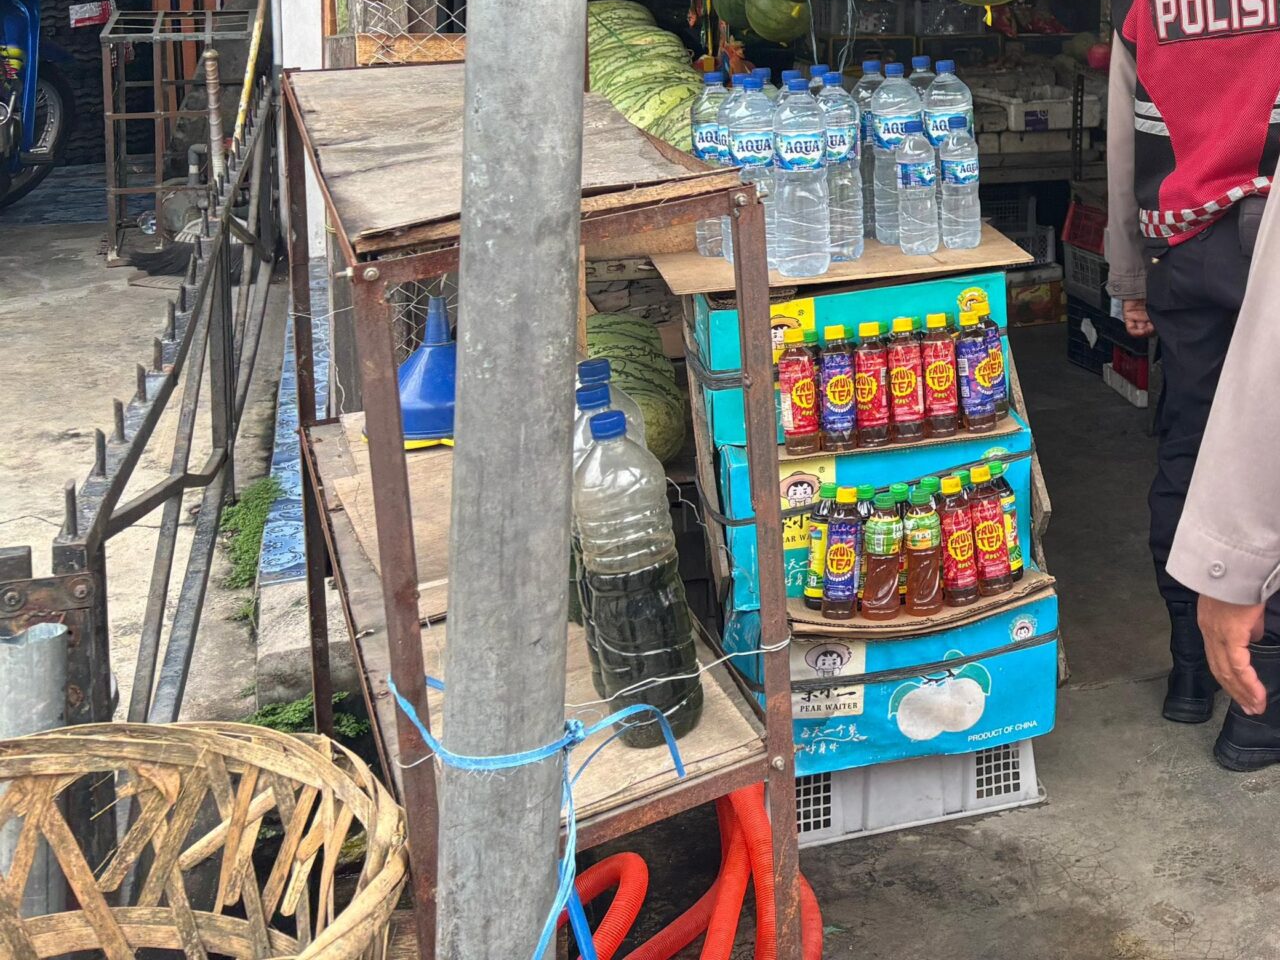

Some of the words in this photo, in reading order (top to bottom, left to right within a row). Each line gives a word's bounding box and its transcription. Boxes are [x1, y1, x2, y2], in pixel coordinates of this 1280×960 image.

[736, 138, 772, 155] AQUA
[784, 139, 821, 156] AQUA
[928, 362, 951, 376] FRUIT
[829, 376, 852, 389] FRUIT
[891, 380, 912, 395] TEA
[930, 376, 951, 390] TEA
[830, 387, 852, 401] TEA
[976, 522, 1001, 537] FRUIT
[950, 532, 972, 547] FRUIT
[978, 535, 1002, 549] TEA
[828, 546, 853, 558] FRUIT
[951, 544, 973, 558] TEA
[829, 558, 852, 571] TEA
[800, 704, 822, 713] PEAR
[825, 702, 858, 711] WAITER
[967, 728, 1002, 742] PRODUCT
[1003, 724, 1015, 734] OF
[1014, 719, 1038, 731] CHINA
